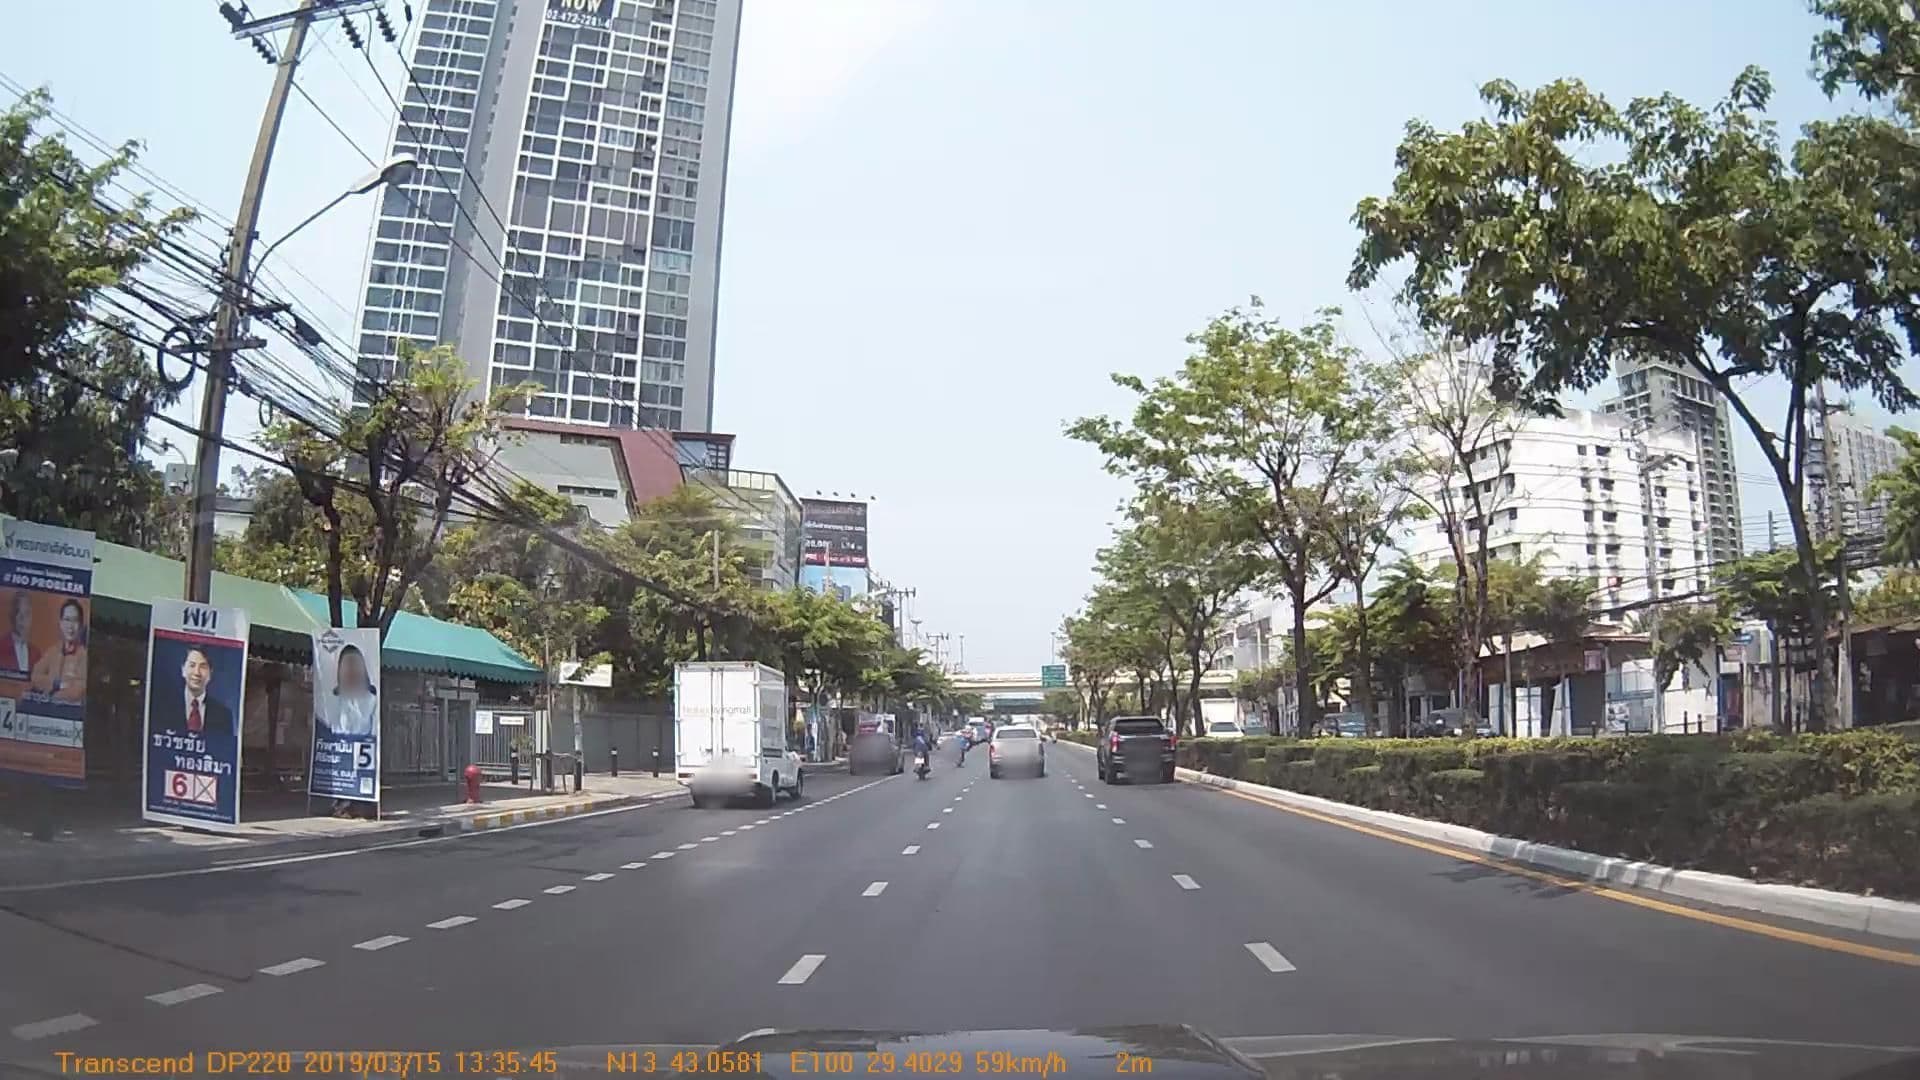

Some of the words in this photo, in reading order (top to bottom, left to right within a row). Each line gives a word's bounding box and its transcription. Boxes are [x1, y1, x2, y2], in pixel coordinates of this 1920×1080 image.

[560, 0, 602, 13] NOW
[30, 576, 84, 595] PROBLEM
[358, 743, 372, 768] 5
[172, 773, 187, 798] 6
